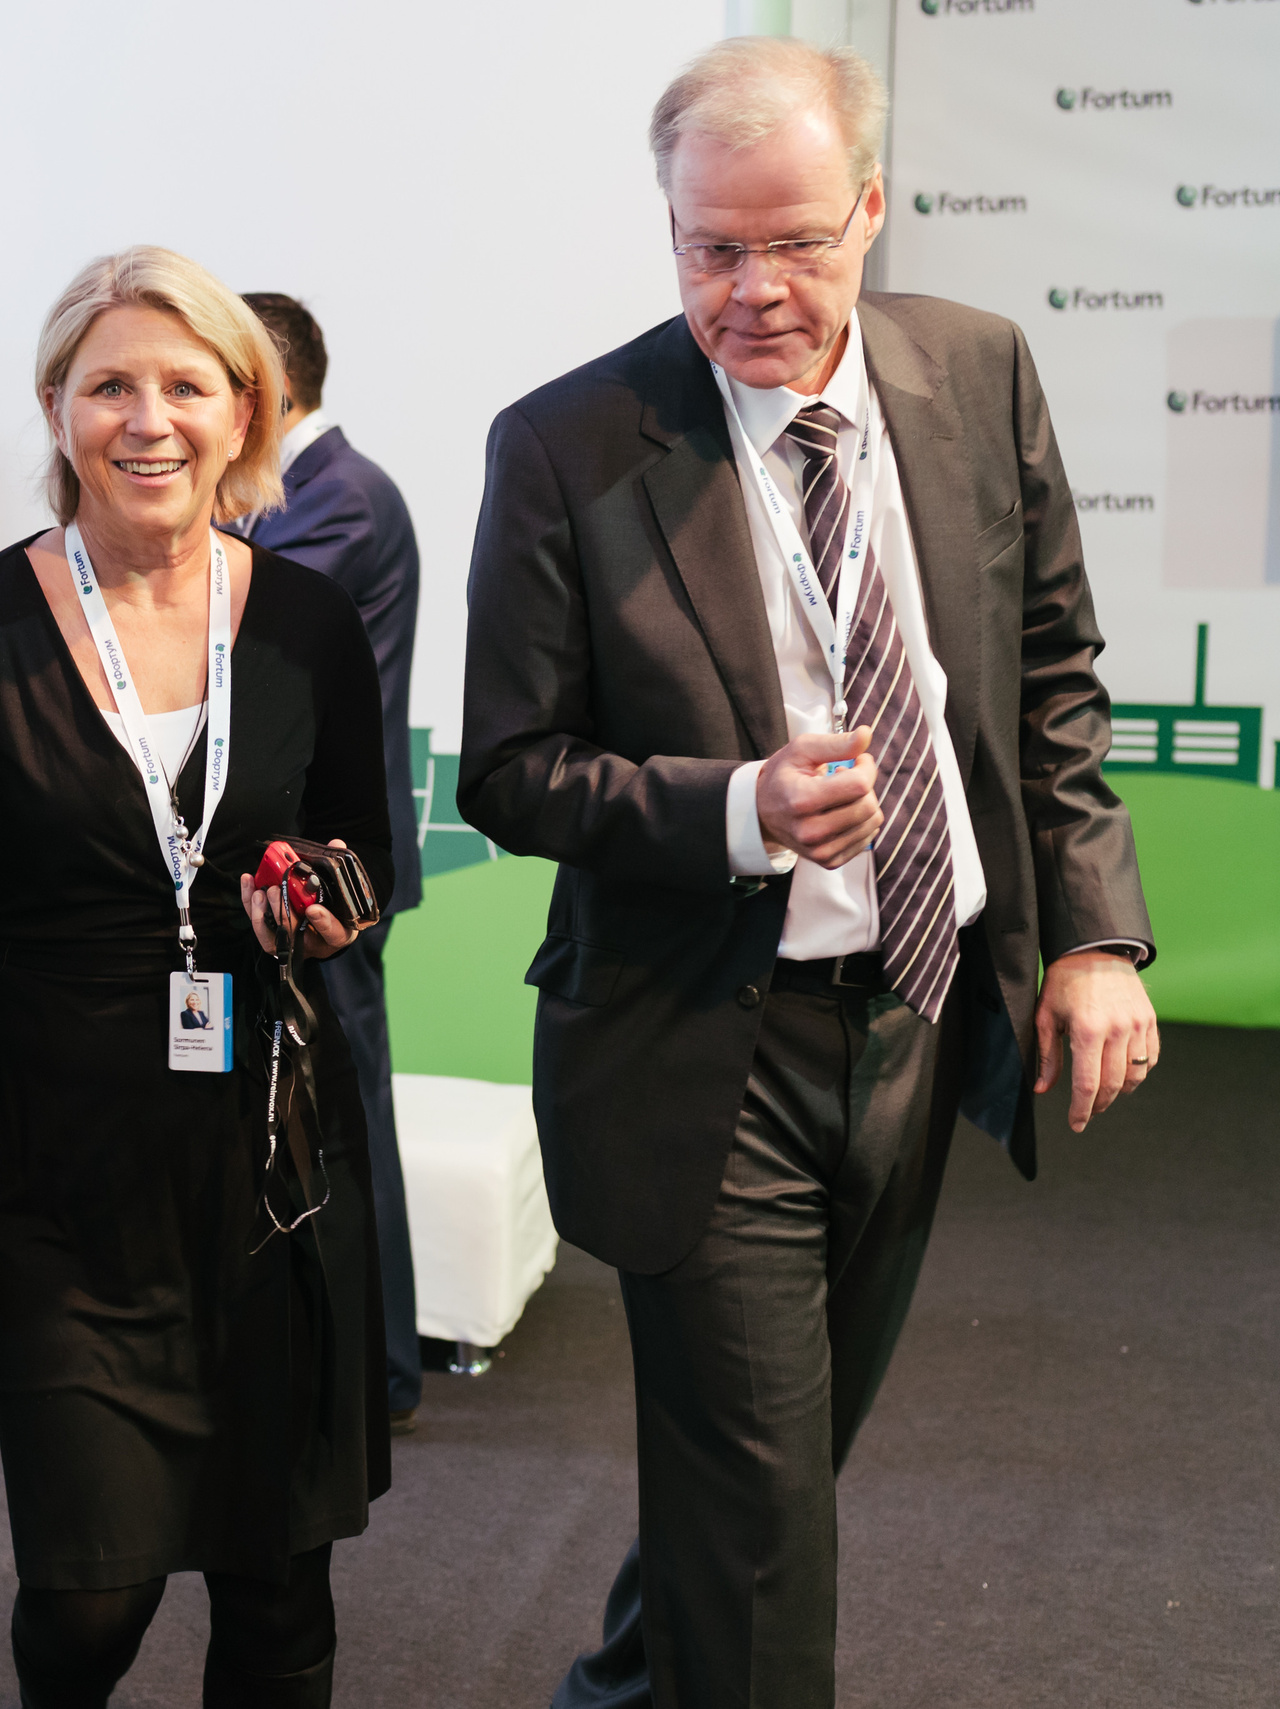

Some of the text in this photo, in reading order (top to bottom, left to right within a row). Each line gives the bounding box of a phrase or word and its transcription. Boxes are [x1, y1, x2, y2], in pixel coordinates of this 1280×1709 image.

[1081, 88, 1173, 110] Fortum
[938, 193, 1027, 214] Fortum
[1073, 289, 1164, 310] Fortum
[1193, 392, 1280, 413] Fortum
[763, 474, 781, 514] Fortum
[1073, 491, 1155, 513] ortum
[851, 510, 865, 549] Fortum
[74, 550, 90, 586] Fortum
[214, 557, 223, 595] Фортум
[797, 563, 818, 606] Фортум
[104, 639, 123, 680] Фортум
[215, 652, 225, 688] Fortum
[138, 737, 156, 774] Fortum
[212, 747, 223, 791] Фортум
[167, 835, 182, 880] Фортум
[268, 1025, 283, 1122] REINVOX www.reinvox.ru
